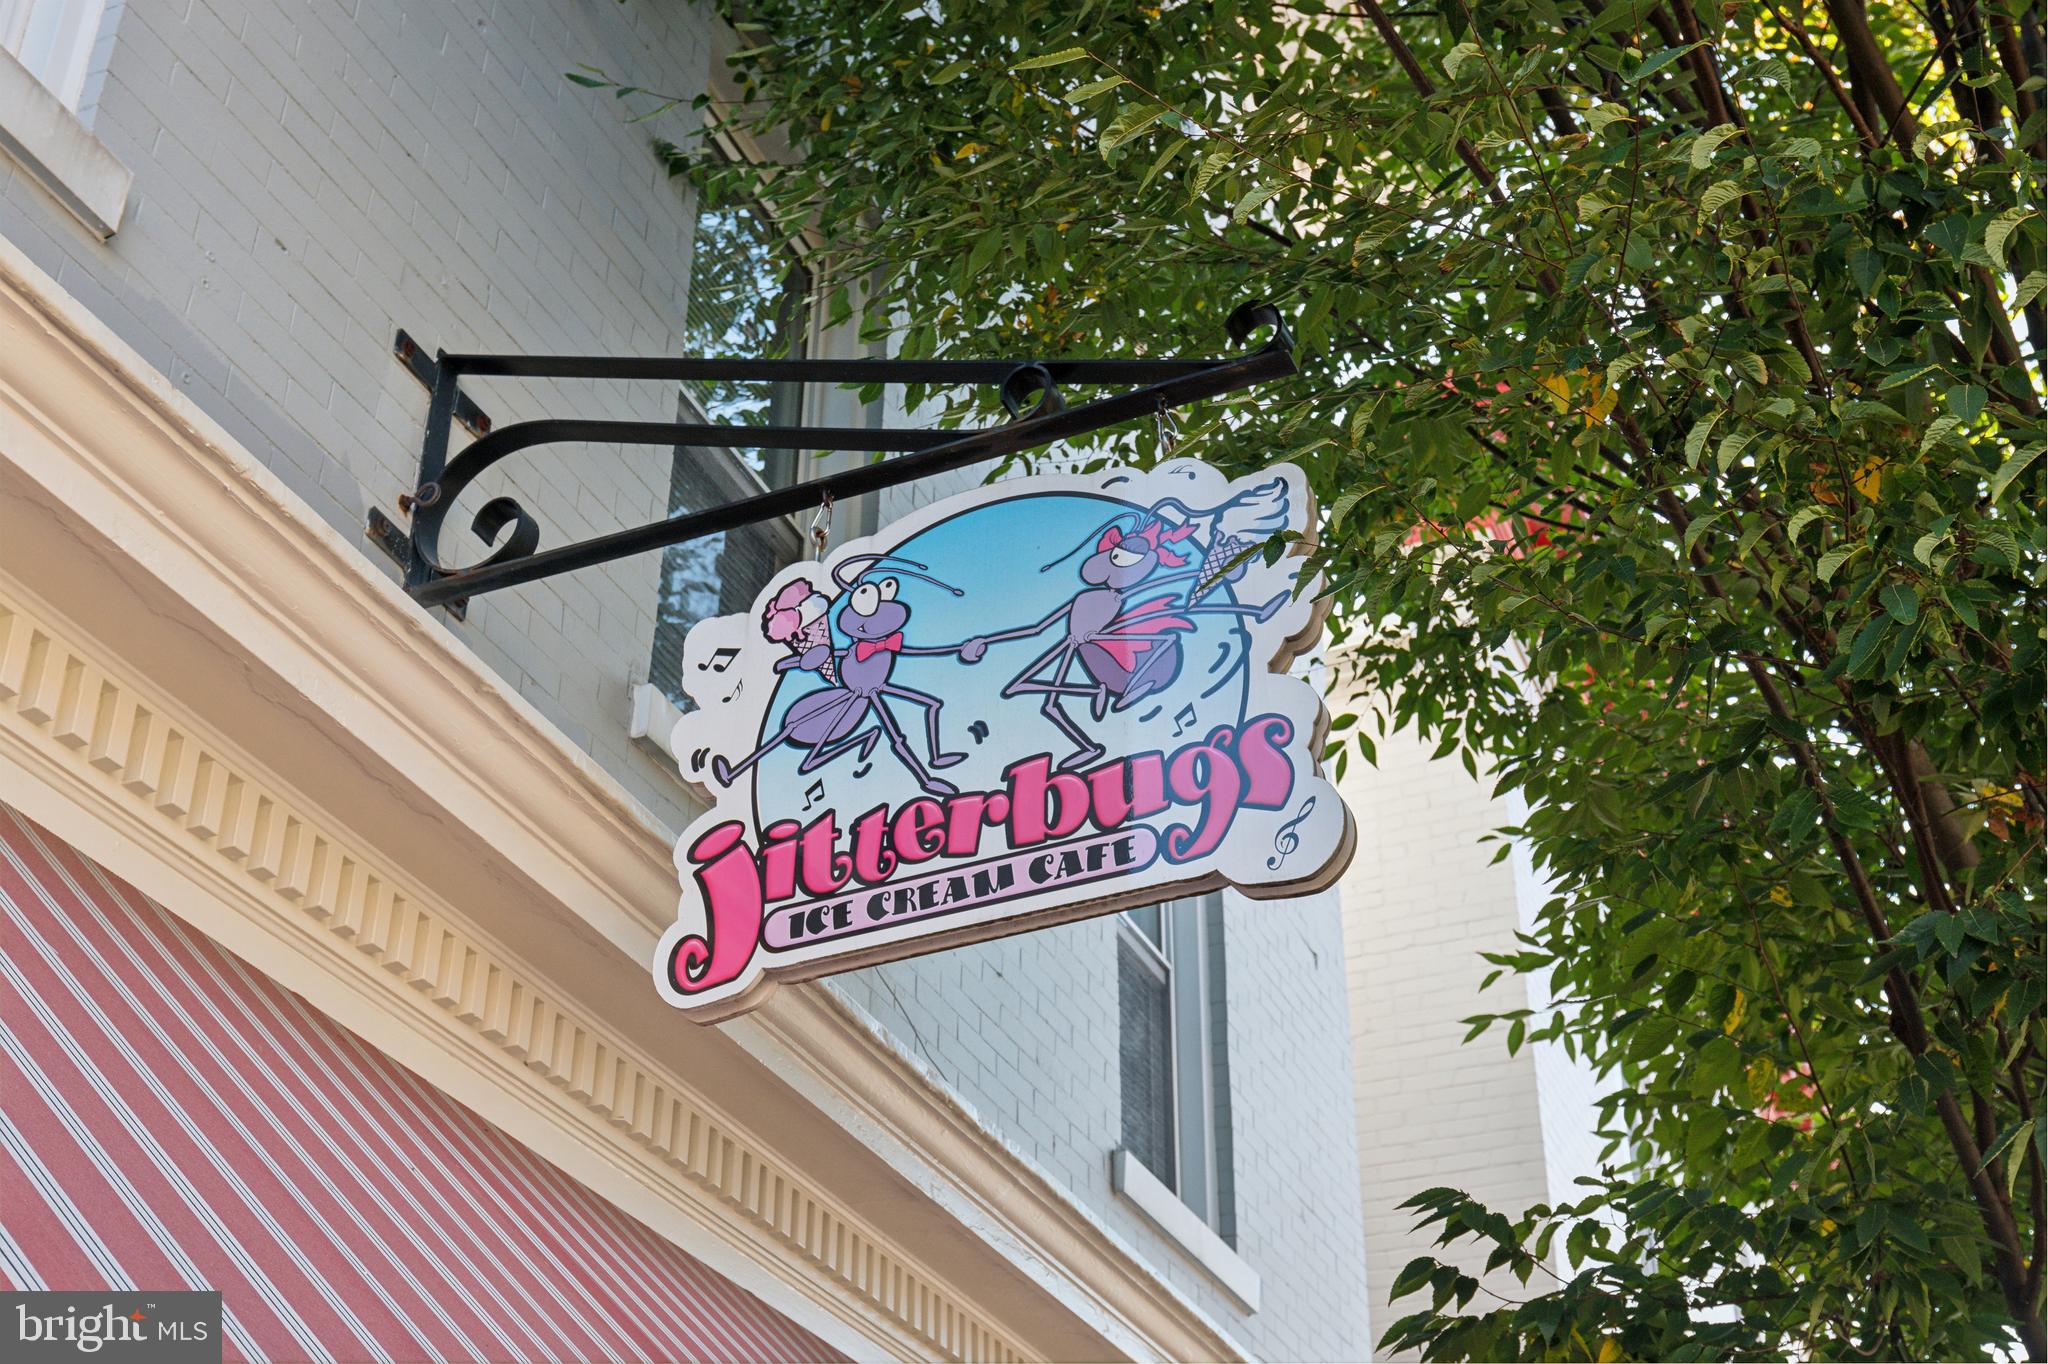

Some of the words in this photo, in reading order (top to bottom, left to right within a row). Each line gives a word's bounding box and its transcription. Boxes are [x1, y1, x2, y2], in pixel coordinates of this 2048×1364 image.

[670, 713, 1297, 995] jitterbugs
[789, 902, 854, 939] ICE
[866, 863, 1016, 920] CREAM
[1029, 836, 1138, 887] CAFE
